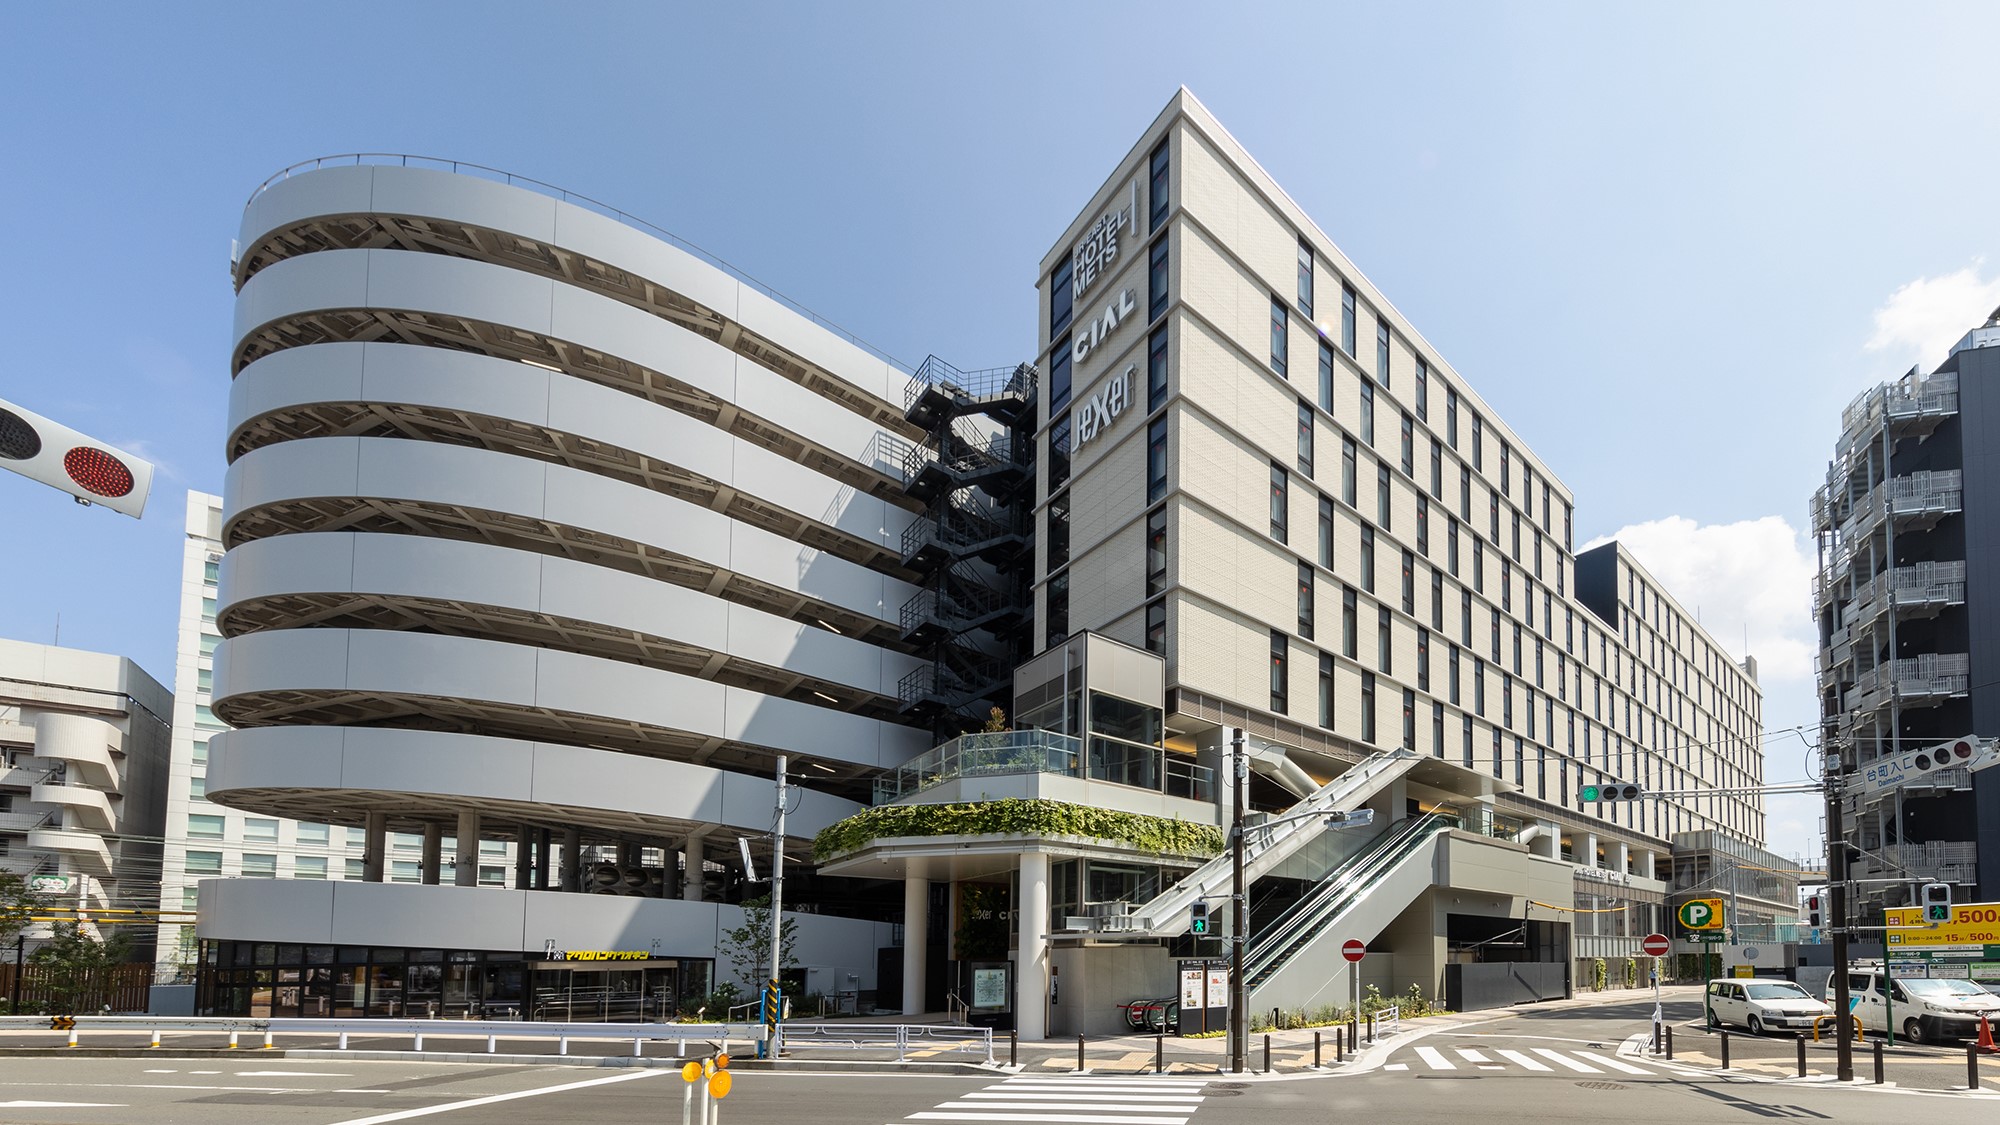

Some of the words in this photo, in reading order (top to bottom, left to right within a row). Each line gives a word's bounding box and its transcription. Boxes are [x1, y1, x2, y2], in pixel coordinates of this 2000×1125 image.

[1074, 209, 1128, 279] HOTEL
[1074, 238, 1118, 299] METS
[1073, 289, 1136, 364] CIAL
[1866, 756, 1914, 782] 台町入口
[1878, 774, 1905, 787] Daimachi
[1690, 905, 1708, 925] P
[1947, 909, 2000, 925] ,500
